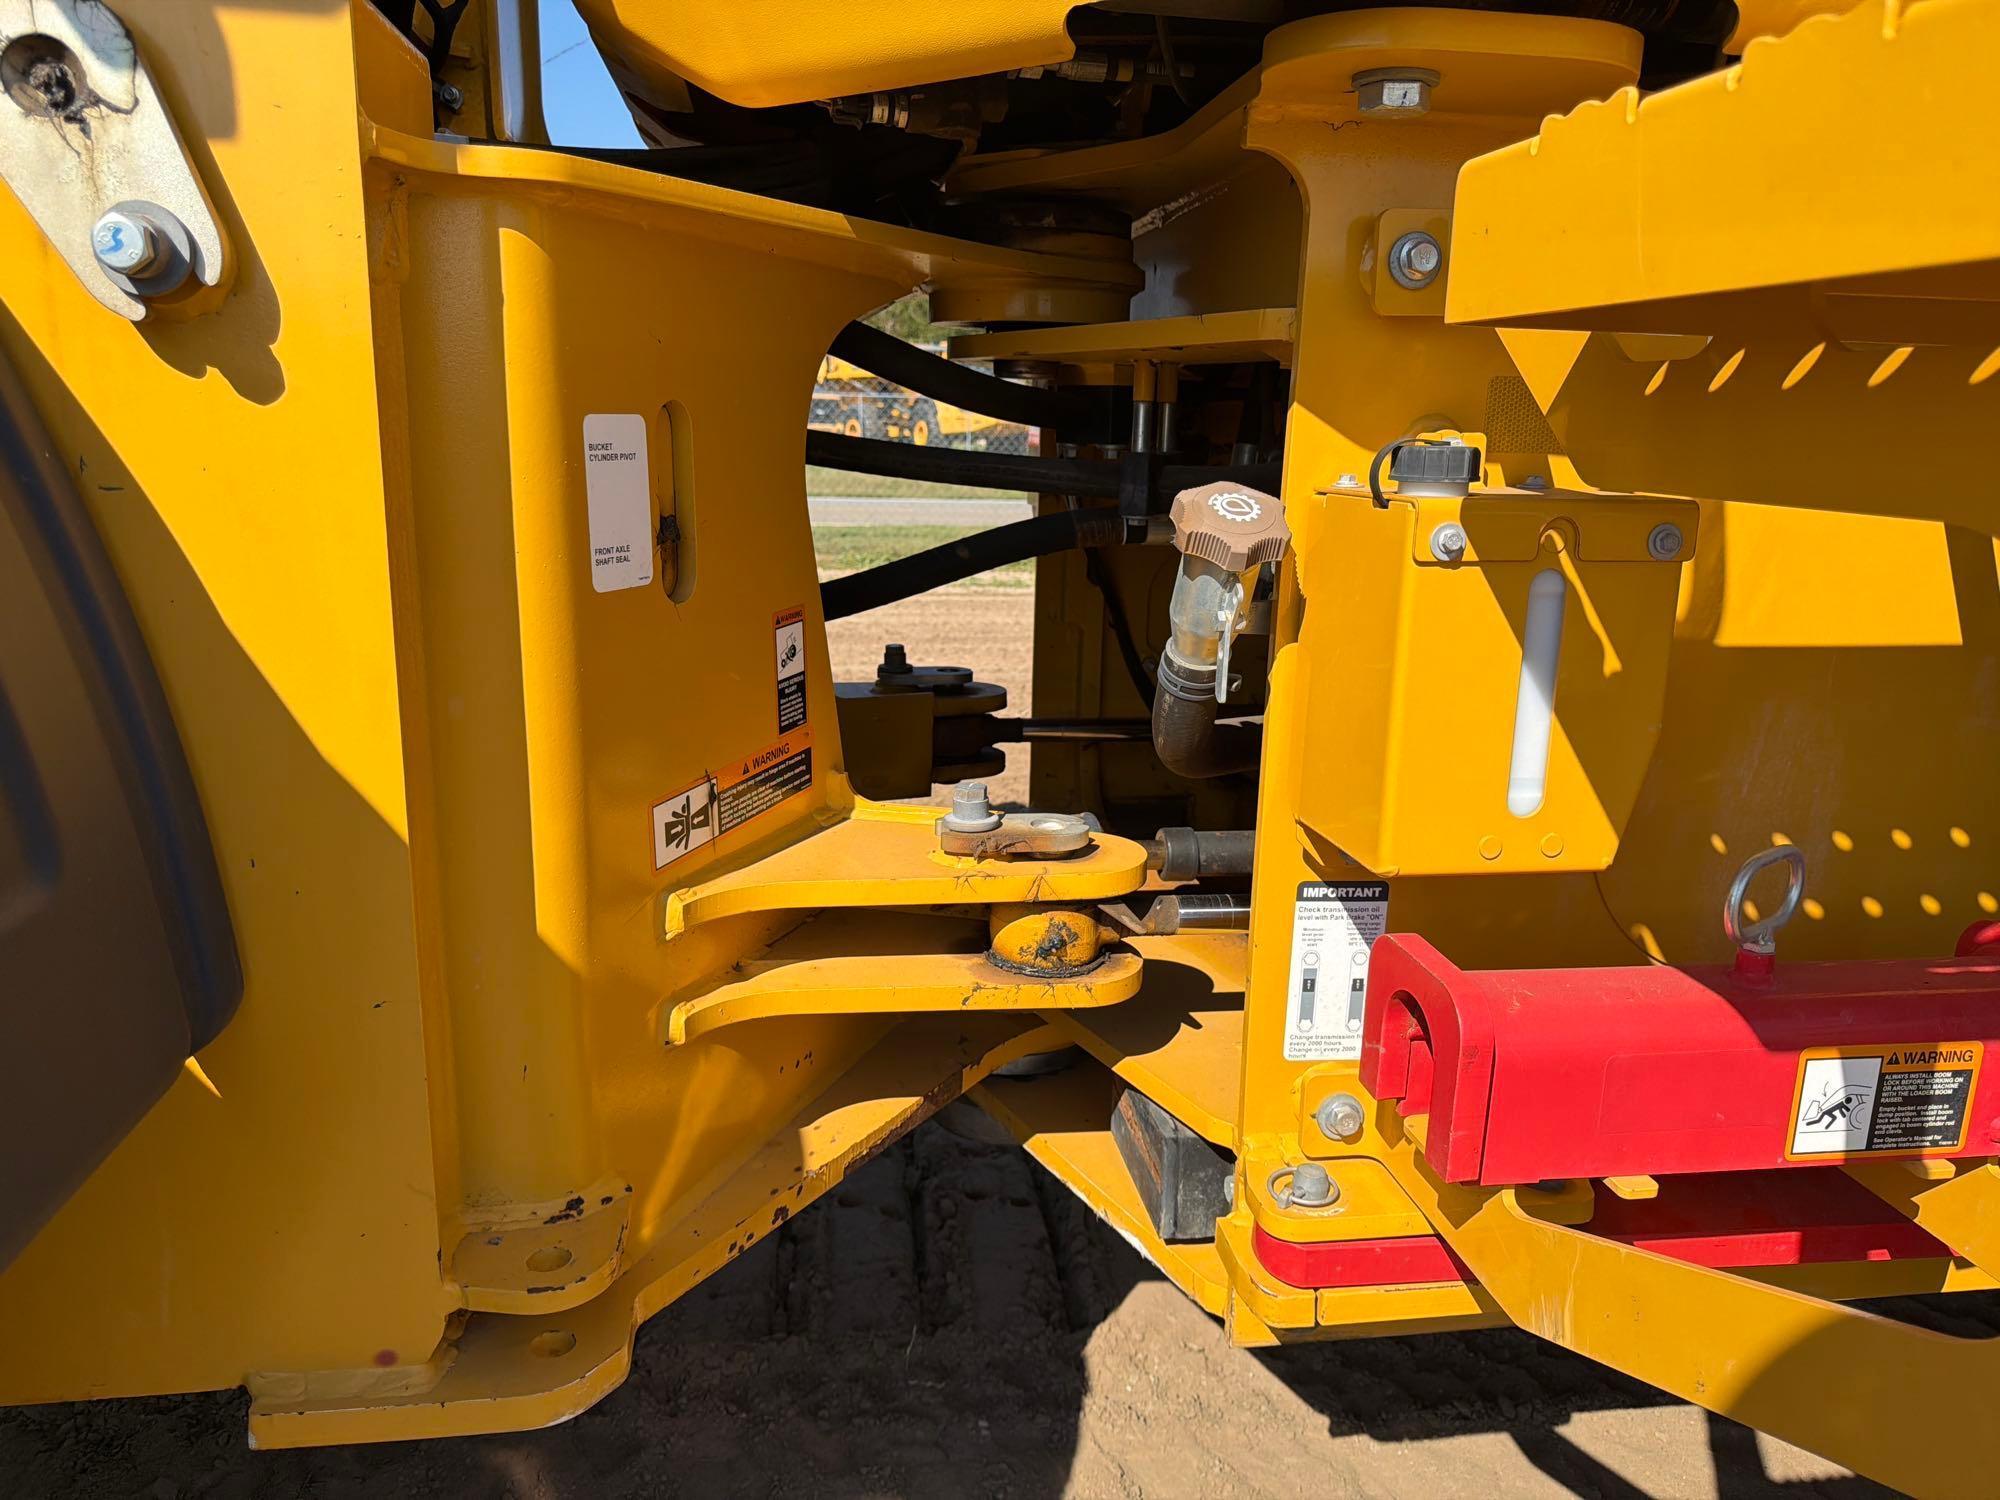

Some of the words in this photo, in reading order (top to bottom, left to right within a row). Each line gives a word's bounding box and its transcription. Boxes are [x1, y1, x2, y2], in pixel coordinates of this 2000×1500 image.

[589, 443, 612, 451] BUCKET
[589, 453, 618, 462] CYLINDER
[595, 547, 614, 556] FRONT
[616, 545, 630, 553] AXLE
[595, 557, 614, 566] SHAFT
[616, 555, 630, 563] SEAL
[752, 743, 790, 770] WARNING
[1303, 887, 1382, 897] IMPORTANT
[1903, 1050, 1973, 1064] WARNING
